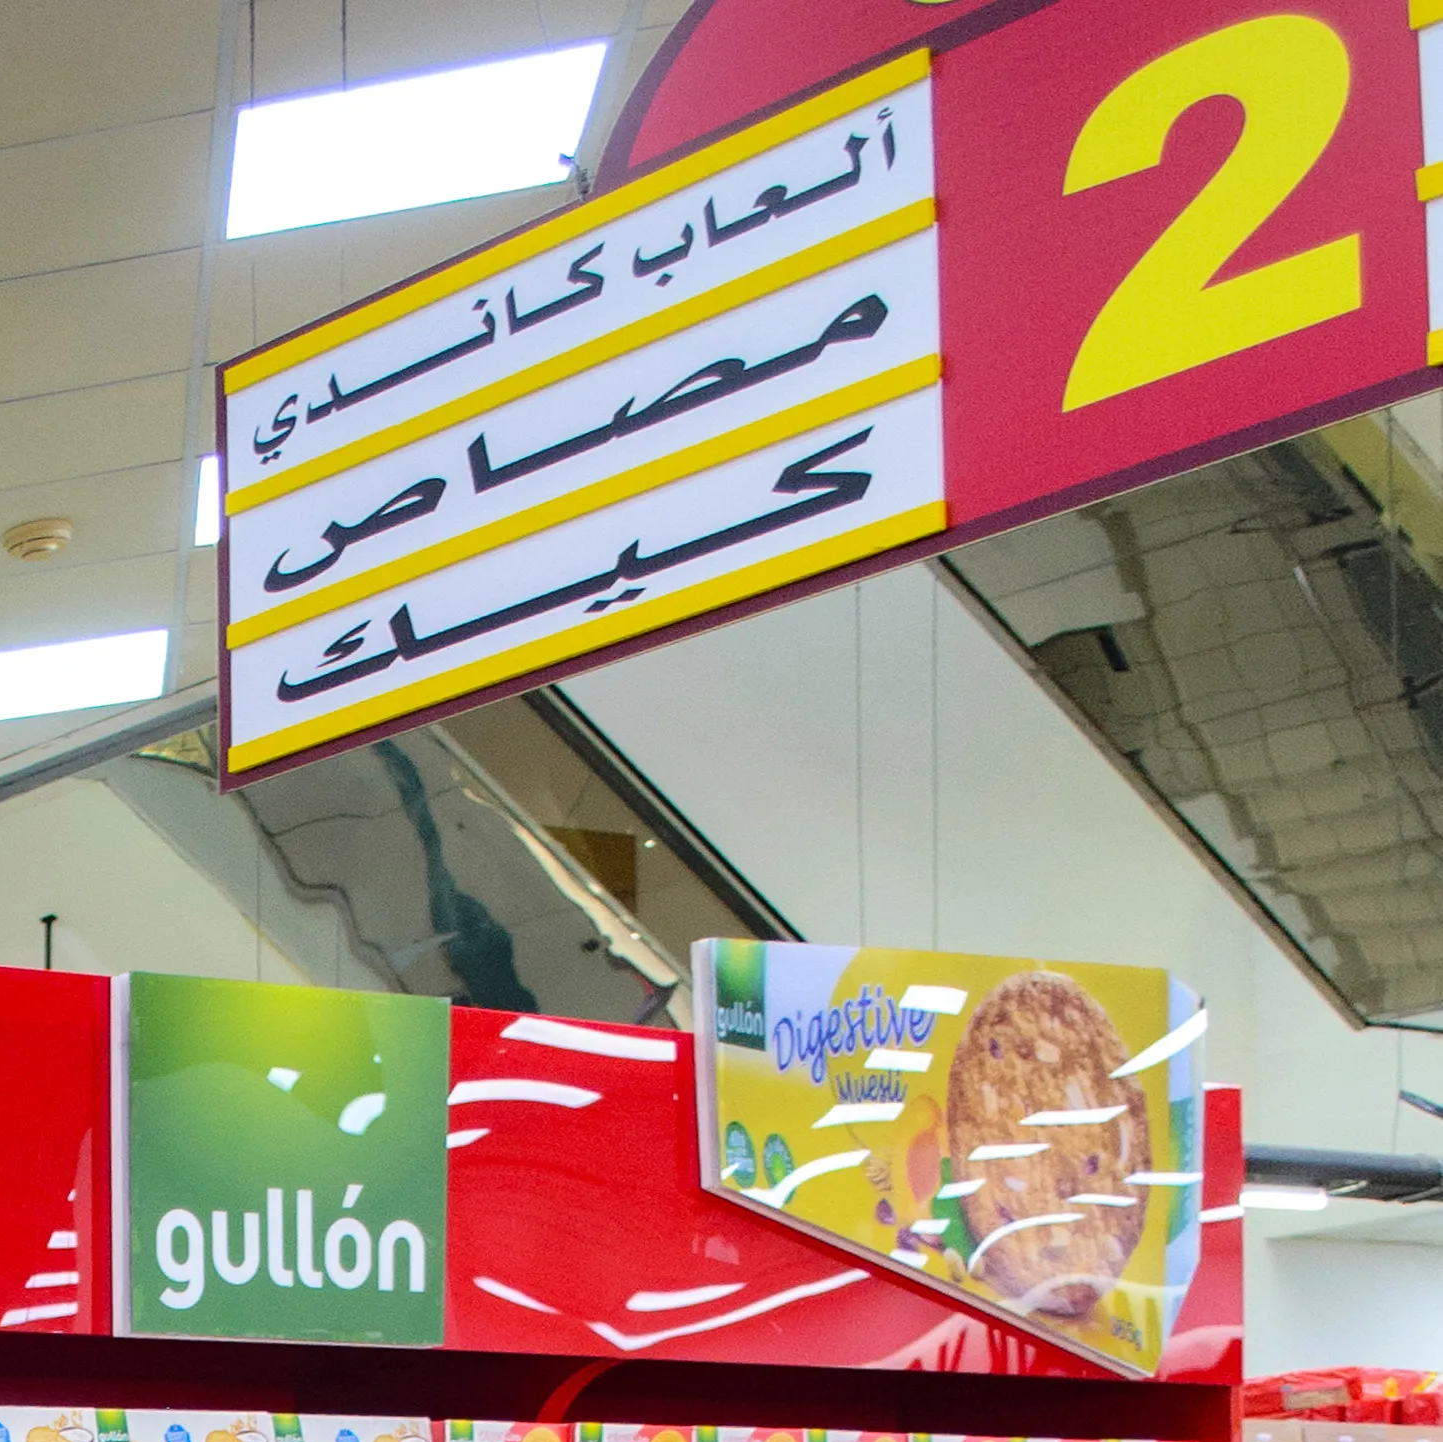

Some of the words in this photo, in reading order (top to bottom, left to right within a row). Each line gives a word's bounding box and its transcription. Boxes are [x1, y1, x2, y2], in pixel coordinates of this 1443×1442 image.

[1062, 12, 1361, 414] 2
[717, 1001, 764, 1037] gullón
[773, 985, 935, 1086] Digestive
[156, 1184, 425, 1310] gullón
